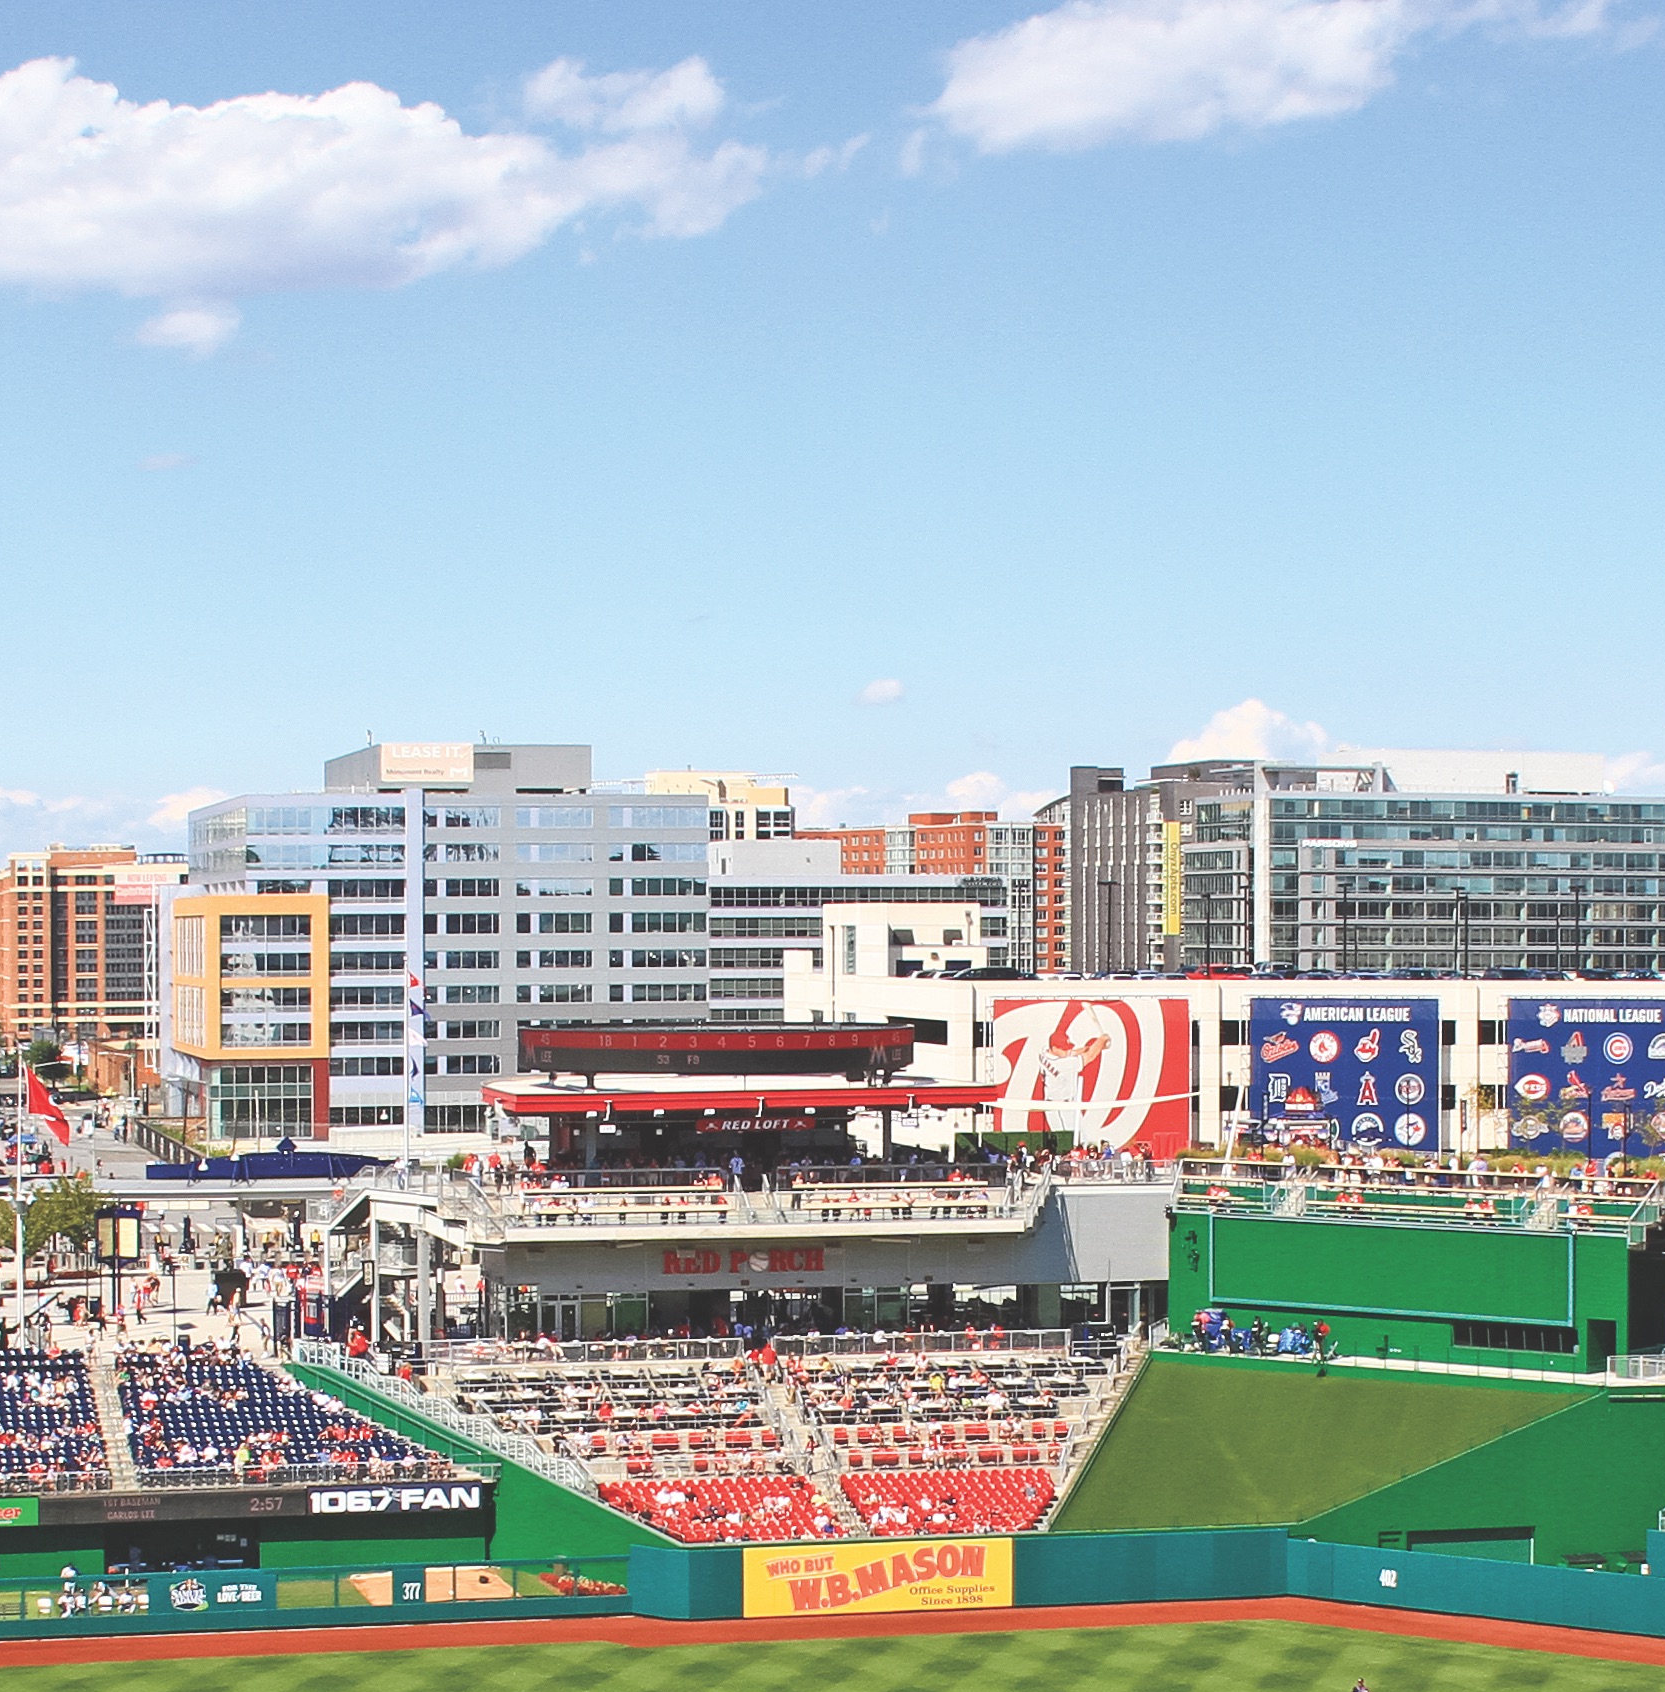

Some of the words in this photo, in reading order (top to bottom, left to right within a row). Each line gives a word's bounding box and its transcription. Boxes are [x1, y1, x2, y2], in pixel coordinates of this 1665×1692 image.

[1303, 1007, 1364, 1022] AMERICAN
[1366, 1007, 1411, 1022] LEAGUE
[1563, 1008, 1617, 1023] NATIONAL
[1618, 1008, 1662, 1023] LEAGUE
[599, 1035, 613, 1048] 1B
[632, 1035, 638, 1048] 1
[659, 1035, 668, 1048] 2
[688, 1035, 698, 1048] 3
[717, 1035, 727, 1048] 4
[747, 1035, 757, 1048] 5
[776, 1035, 785, 1048] 6
[803, 1035, 811, 1048] 7
[827, 1035, 836, 1048] 8
[851, 1034, 859, 1047] 9
[657, 1054, 671, 1065] 53
[721, 1119, 751, 1131] RED
[753, 1117, 791, 1130] LOFT
[662, 1251, 721, 1275] RED
[250, 1496, 283, 1512] 2:57
[310, 1491, 392, 1515] 106.7
[399, 1486, 481, 1511] FAN
[107, 1510, 138, 1520] CARLOS
[139, 1509, 156, 1520] LEE
[765, 1559, 803, 1578] WHO
[804, 1556, 834, 1574] BUT
[1379, 1568, 1397, 1588] 402
[170, 1588, 207, 1599] SAMUEL
[222, 1584, 237, 1592] FOR
[238, 1583, 258, 1591] THE
[401, 1582, 421, 1601] 377
[909, 1585, 944, 1595] Office
[946, 1584, 996, 1596] Supplies
[172, 1596, 208, 1607] ADAMS
[217, 1590, 237, 1603] LOVE
[921, 1596, 954, 1606] Since
[956, 1594, 984, 1605] 1898
